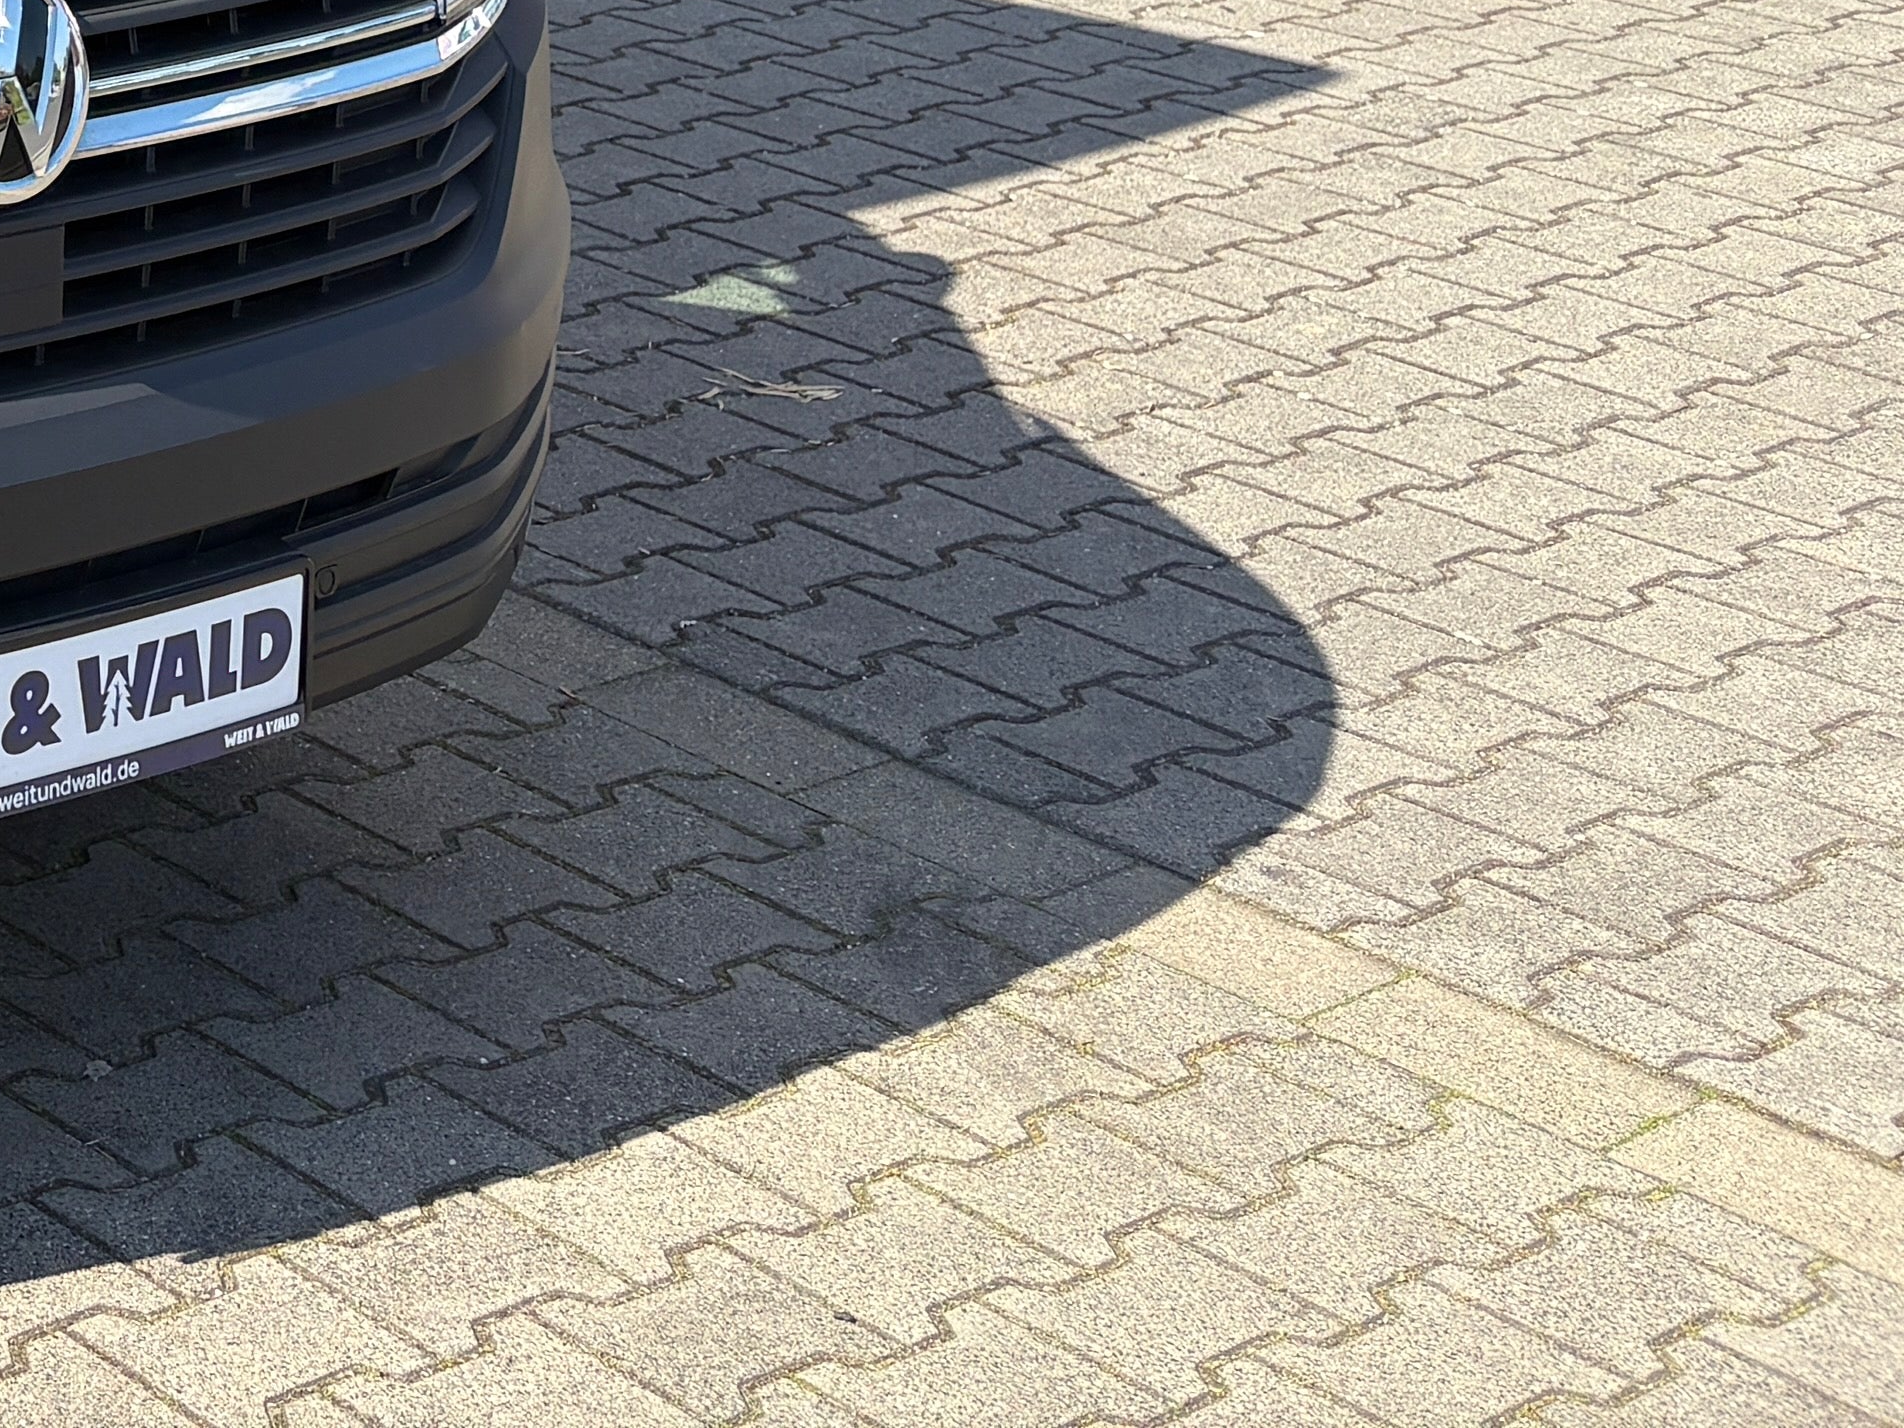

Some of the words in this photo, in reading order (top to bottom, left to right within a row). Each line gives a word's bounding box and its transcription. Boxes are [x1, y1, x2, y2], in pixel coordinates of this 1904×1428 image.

[1, 670, 63, 755] &
[77, 607, 293, 734] WALD
[224, 726, 254, 748] WEIT
